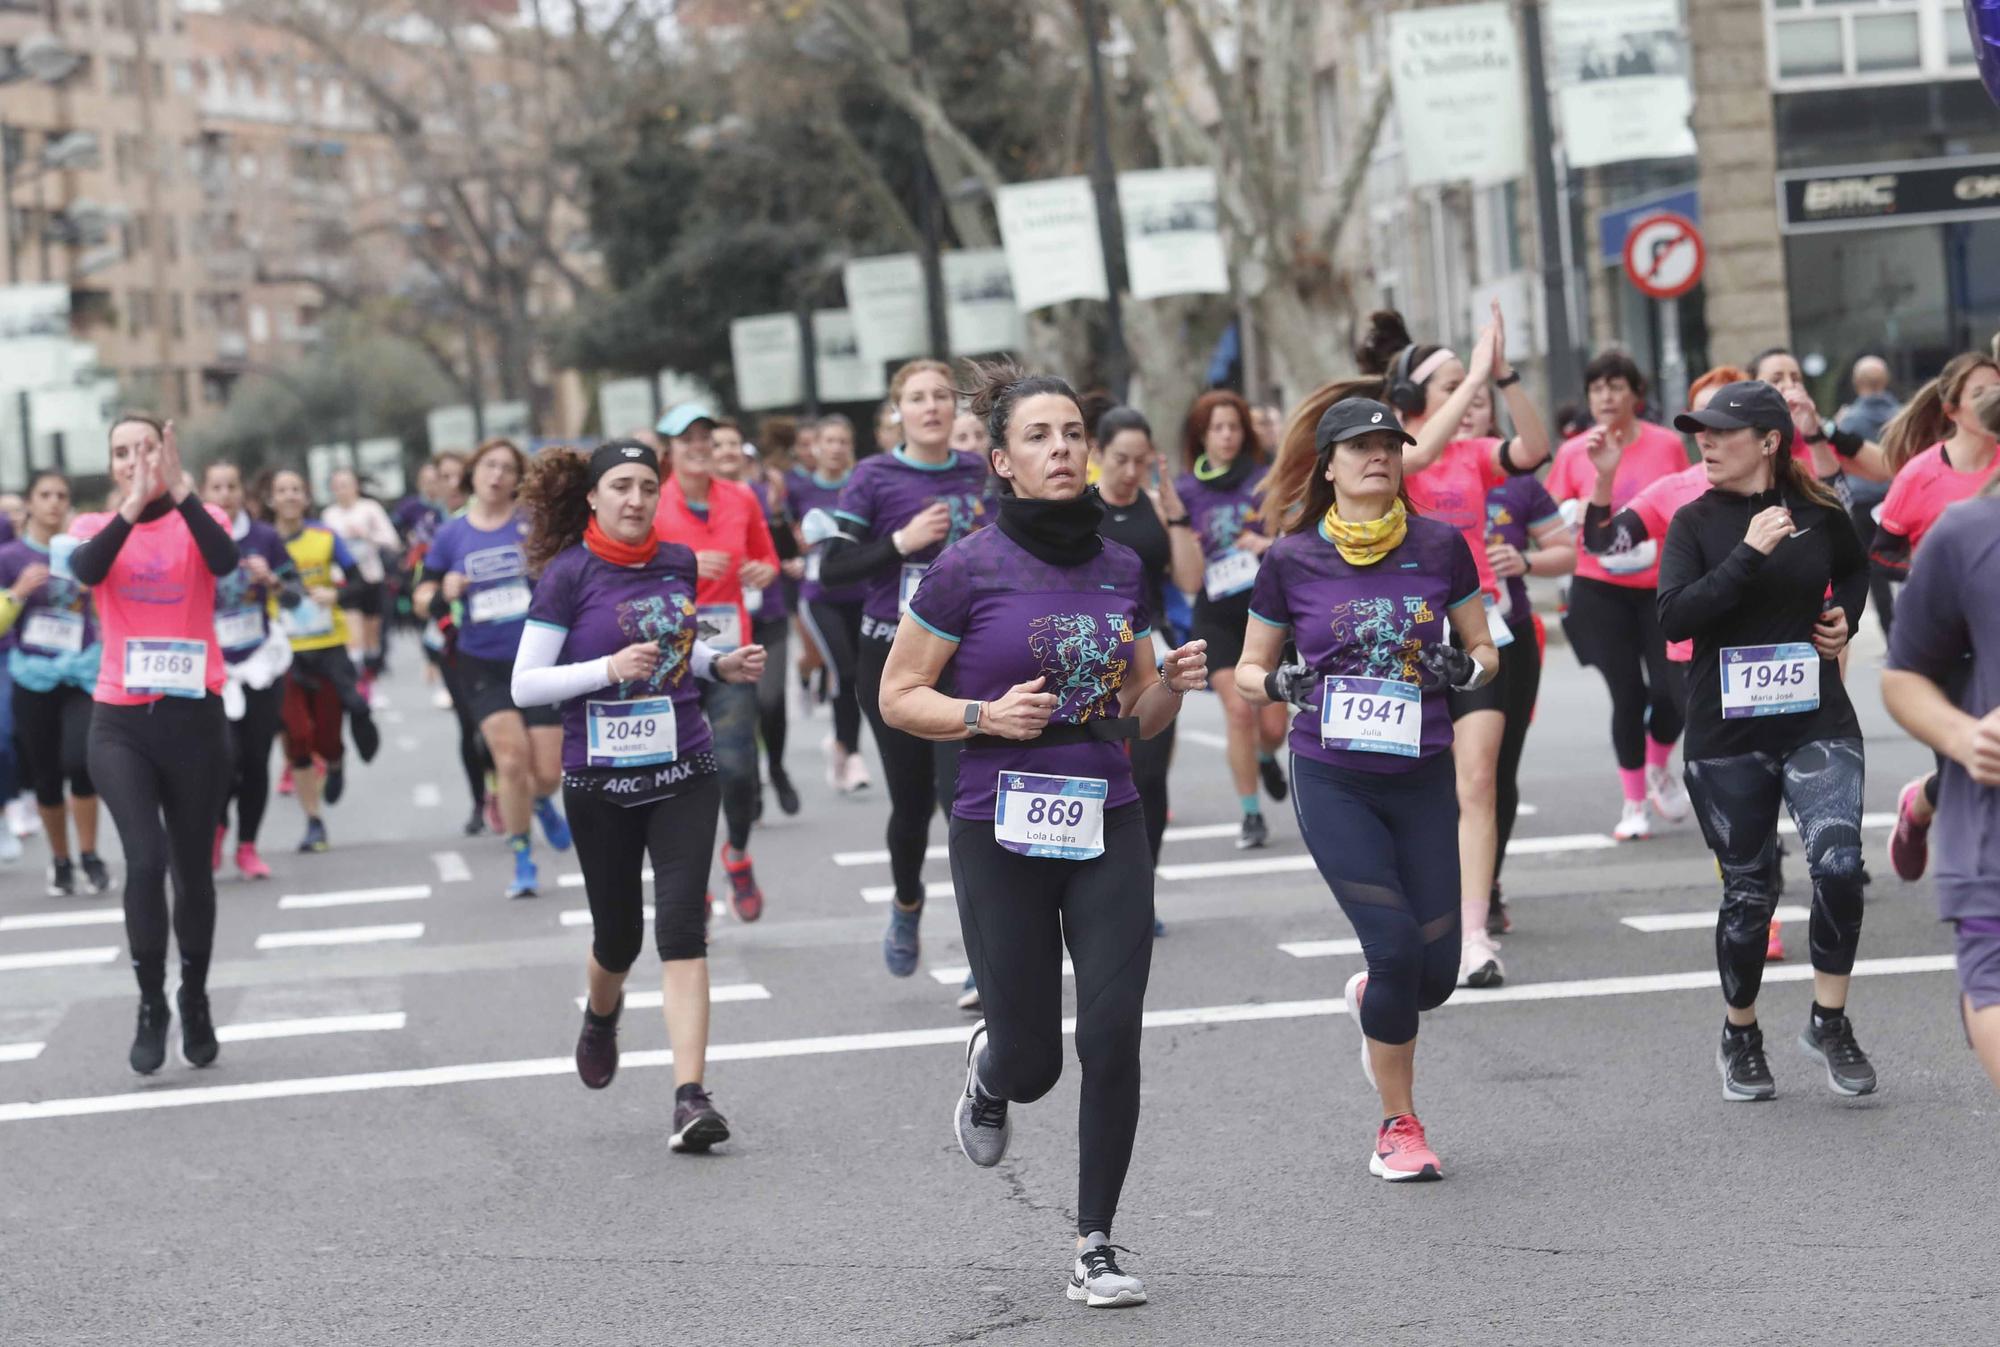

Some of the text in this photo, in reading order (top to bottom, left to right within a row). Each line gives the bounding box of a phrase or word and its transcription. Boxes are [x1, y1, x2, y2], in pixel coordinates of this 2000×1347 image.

[143, 655, 193, 674] 1869
[1740, 662, 1805, 688] 1945
[1342, 697, 1406, 725] 1941
[606, 719, 656, 740] 2049
[1361, 729, 1382, 737] Julia
[655, 761, 694, 788] MAX
[1027, 797, 1084, 827] 869
[1026, 831, 1047, 841] Lola
